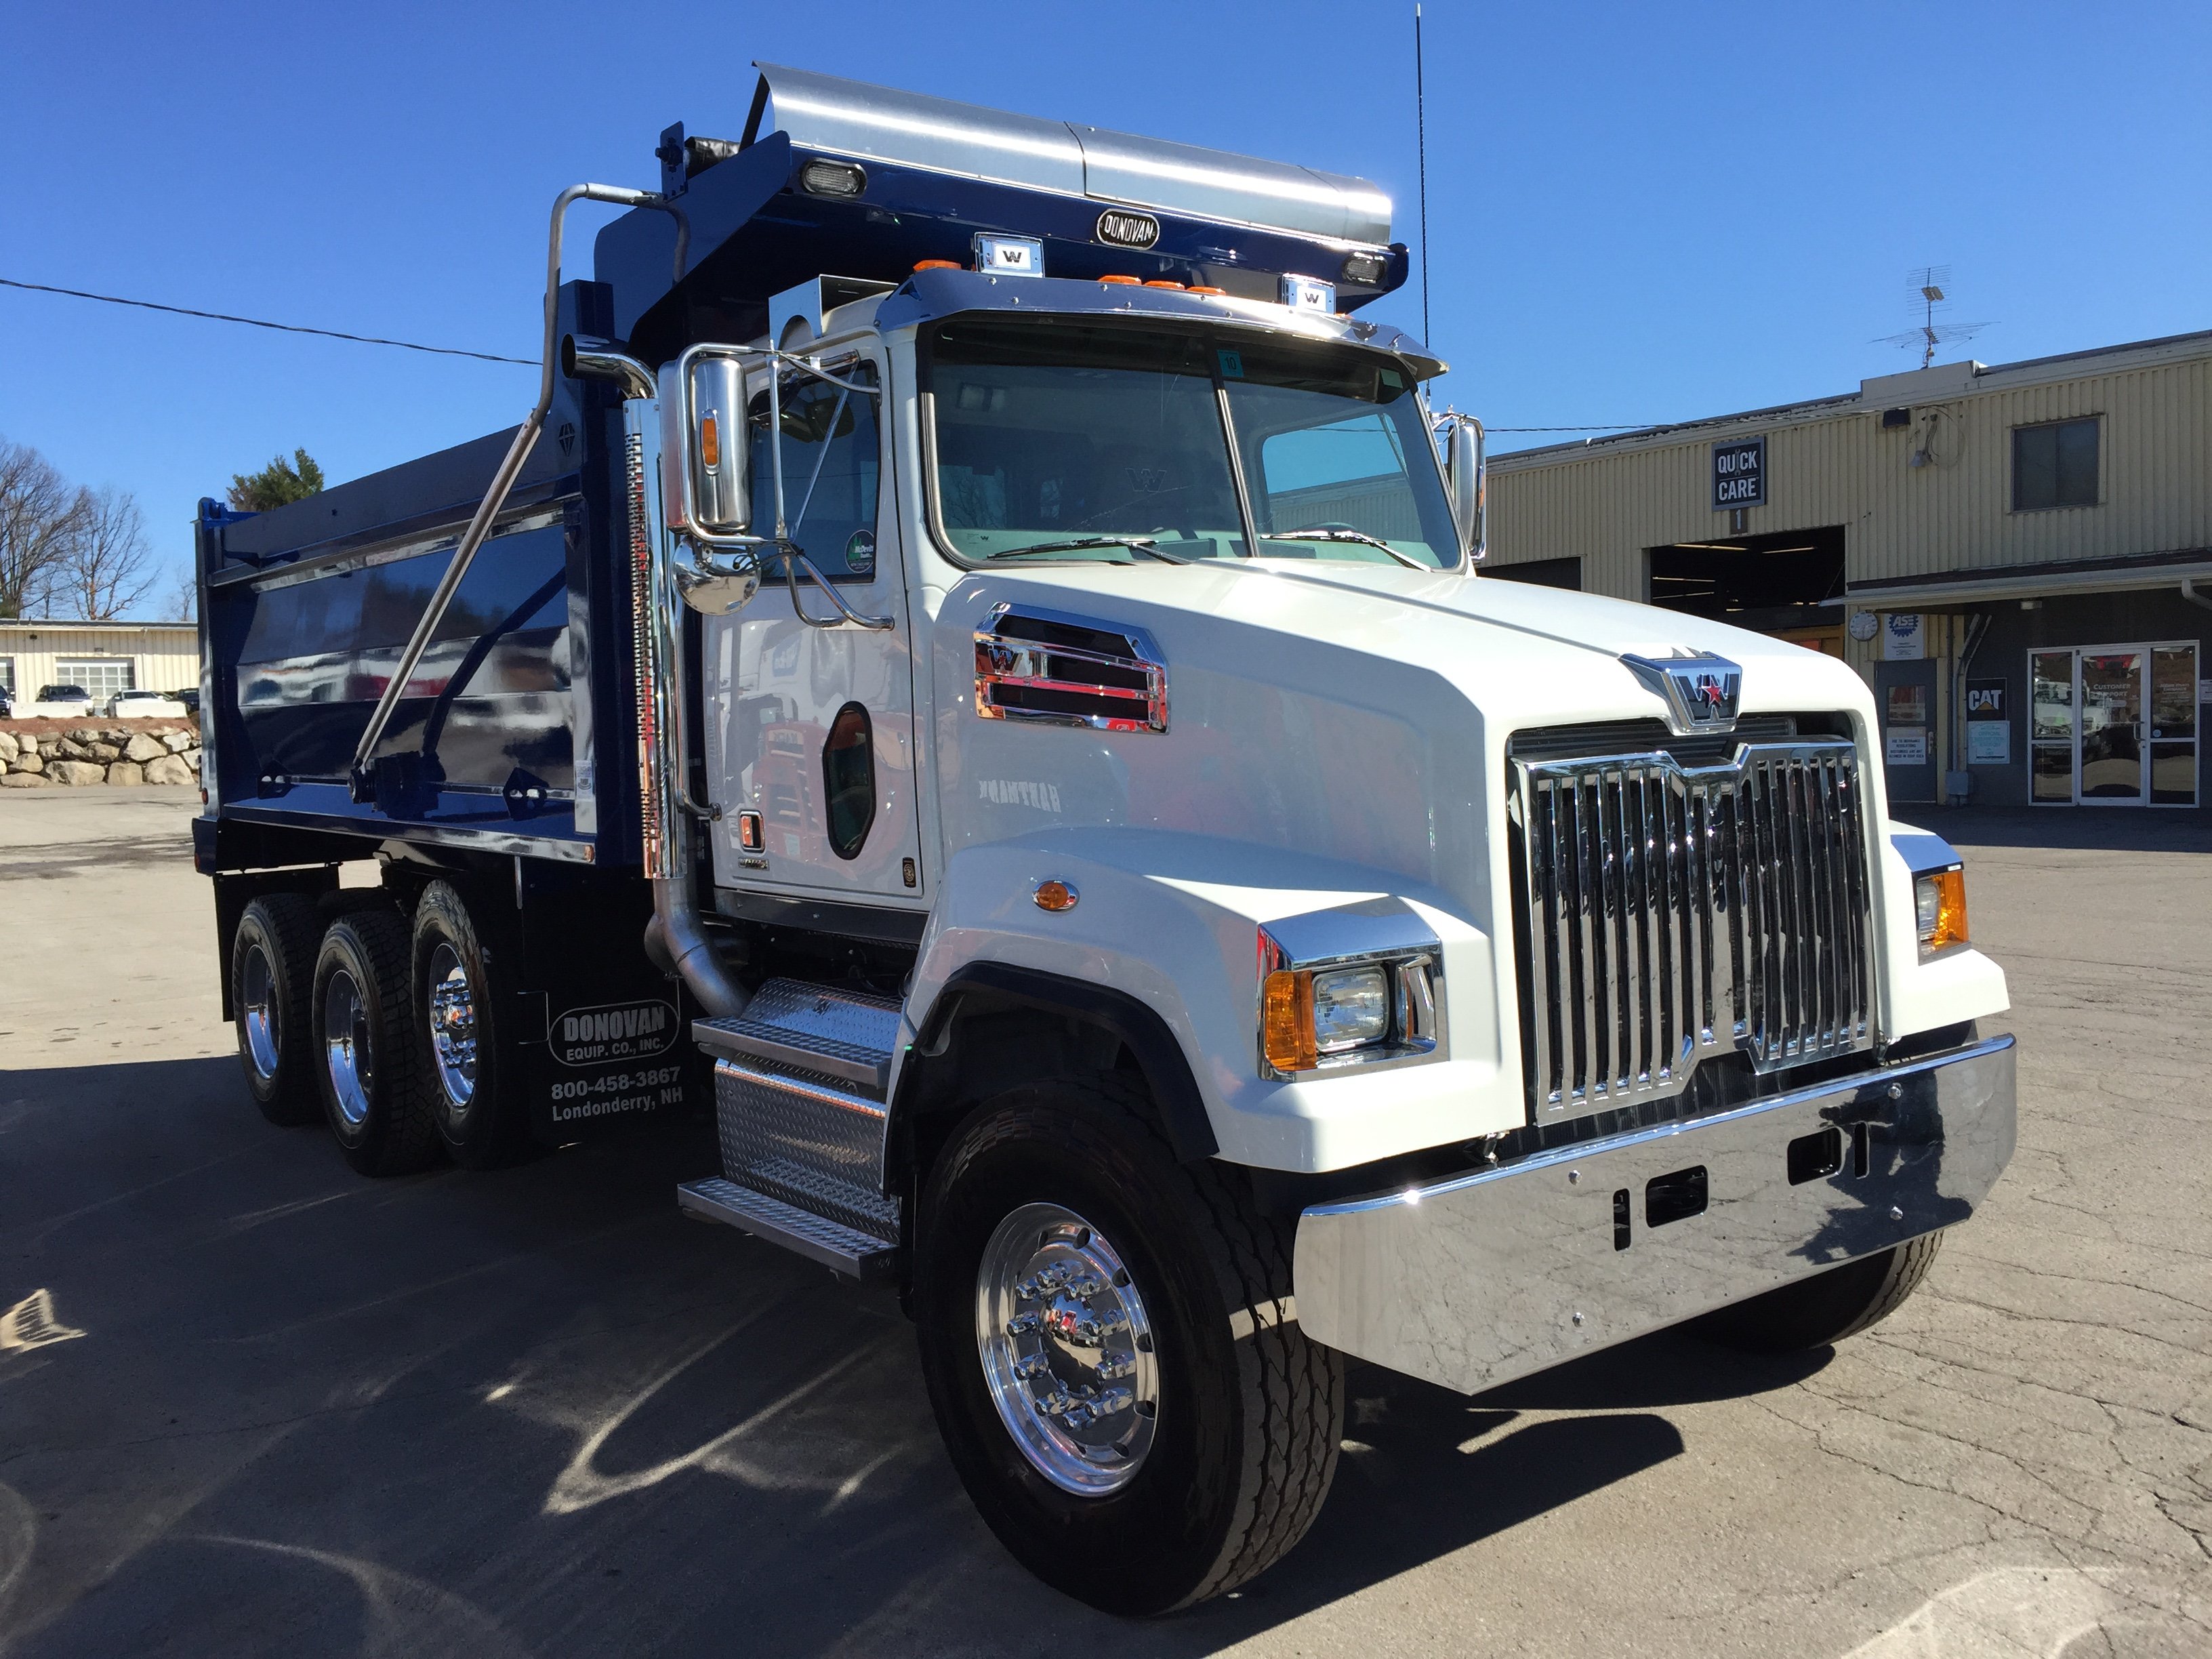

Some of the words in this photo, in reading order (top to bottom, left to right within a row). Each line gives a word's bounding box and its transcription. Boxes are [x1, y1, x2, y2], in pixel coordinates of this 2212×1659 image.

[1104, 215, 1153, 243] DONOVAN
[1225, 356, 1237, 370] 10
[1718, 450, 1758, 474] QUICK
[1719, 477, 1757, 501] CARE
[1736, 509, 1742, 530] 1
[1893, 615, 1914, 627] ASE
[1969, 690, 2002, 710] CAT
[564, 1006, 665, 1042] DONOVAN
[567, 1044, 609, 1061] EQUIP.
[612, 1042, 636, 1055] CO.,
[639, 1038, 664, 1050] INC.
[551, 1066, 681, 1100] 800-458-3867
[552, 1095, 656, 1122] Londonderry,
[660, 1086, 683, 1105] NH
